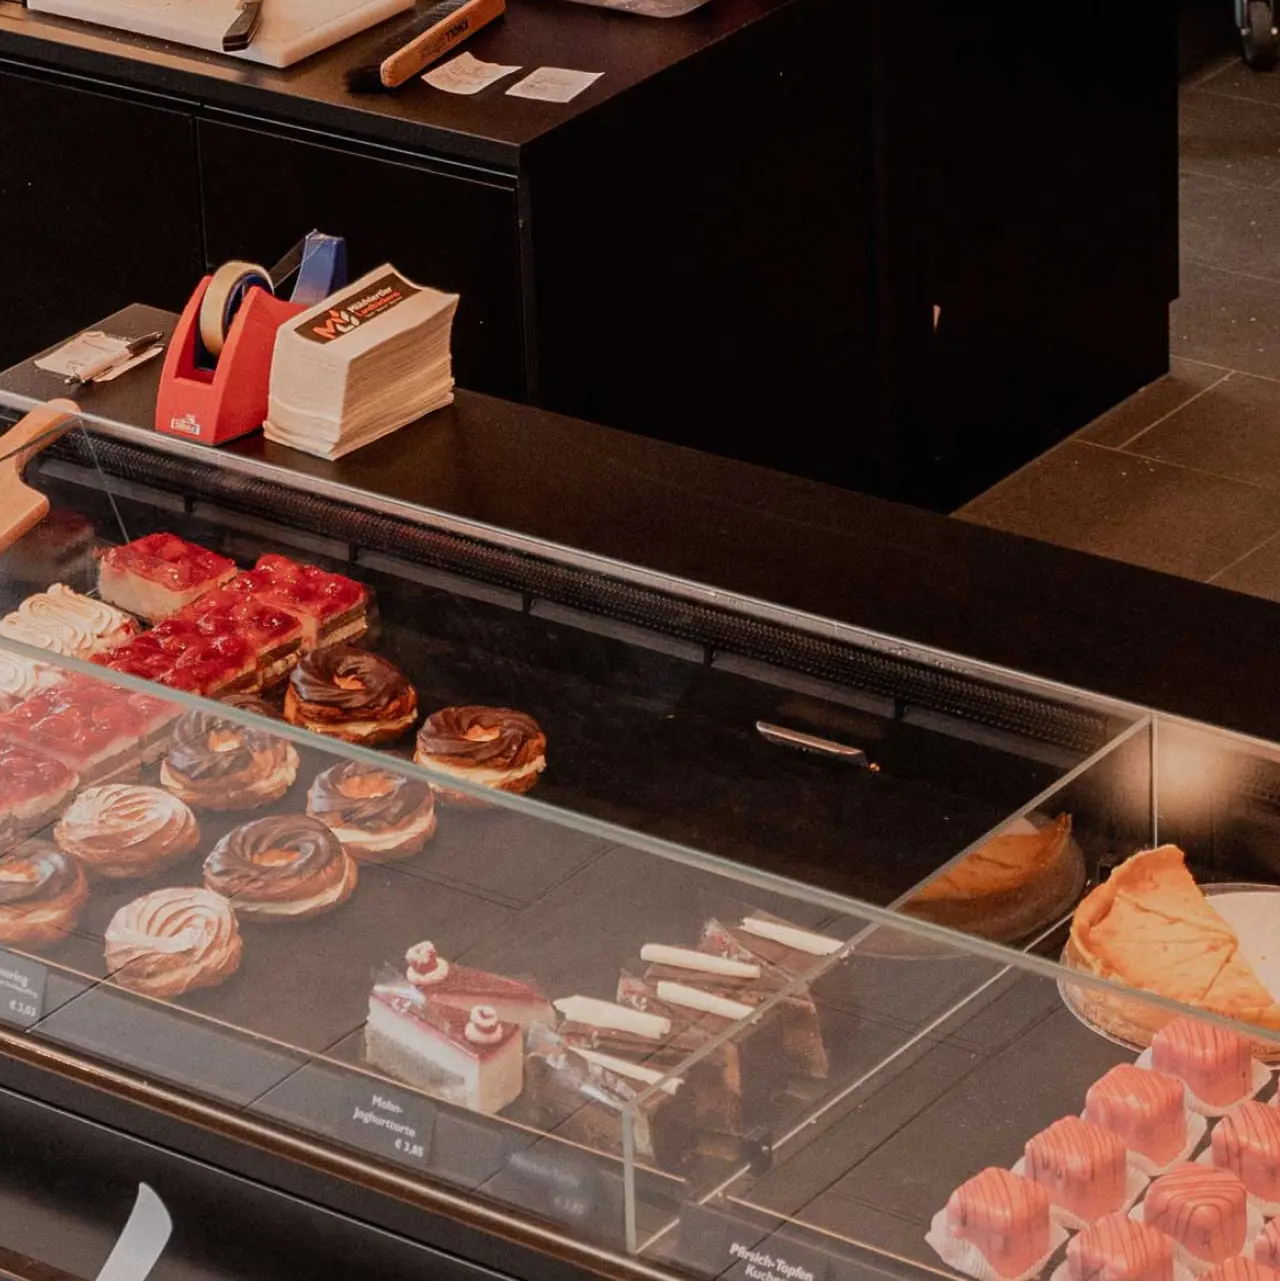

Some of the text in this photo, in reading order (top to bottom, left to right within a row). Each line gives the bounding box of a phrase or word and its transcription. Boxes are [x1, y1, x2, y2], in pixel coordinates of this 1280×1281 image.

[372, 1094, 403, 1114] Mohn-
[352, 1106, 416, 1137] Joghurttorte
[394, 1138, 402, 1150] €
[729, 1242, 814, 1281] Pfirsich-Topfen
[745, 1263, 788, 1281] Kuch
